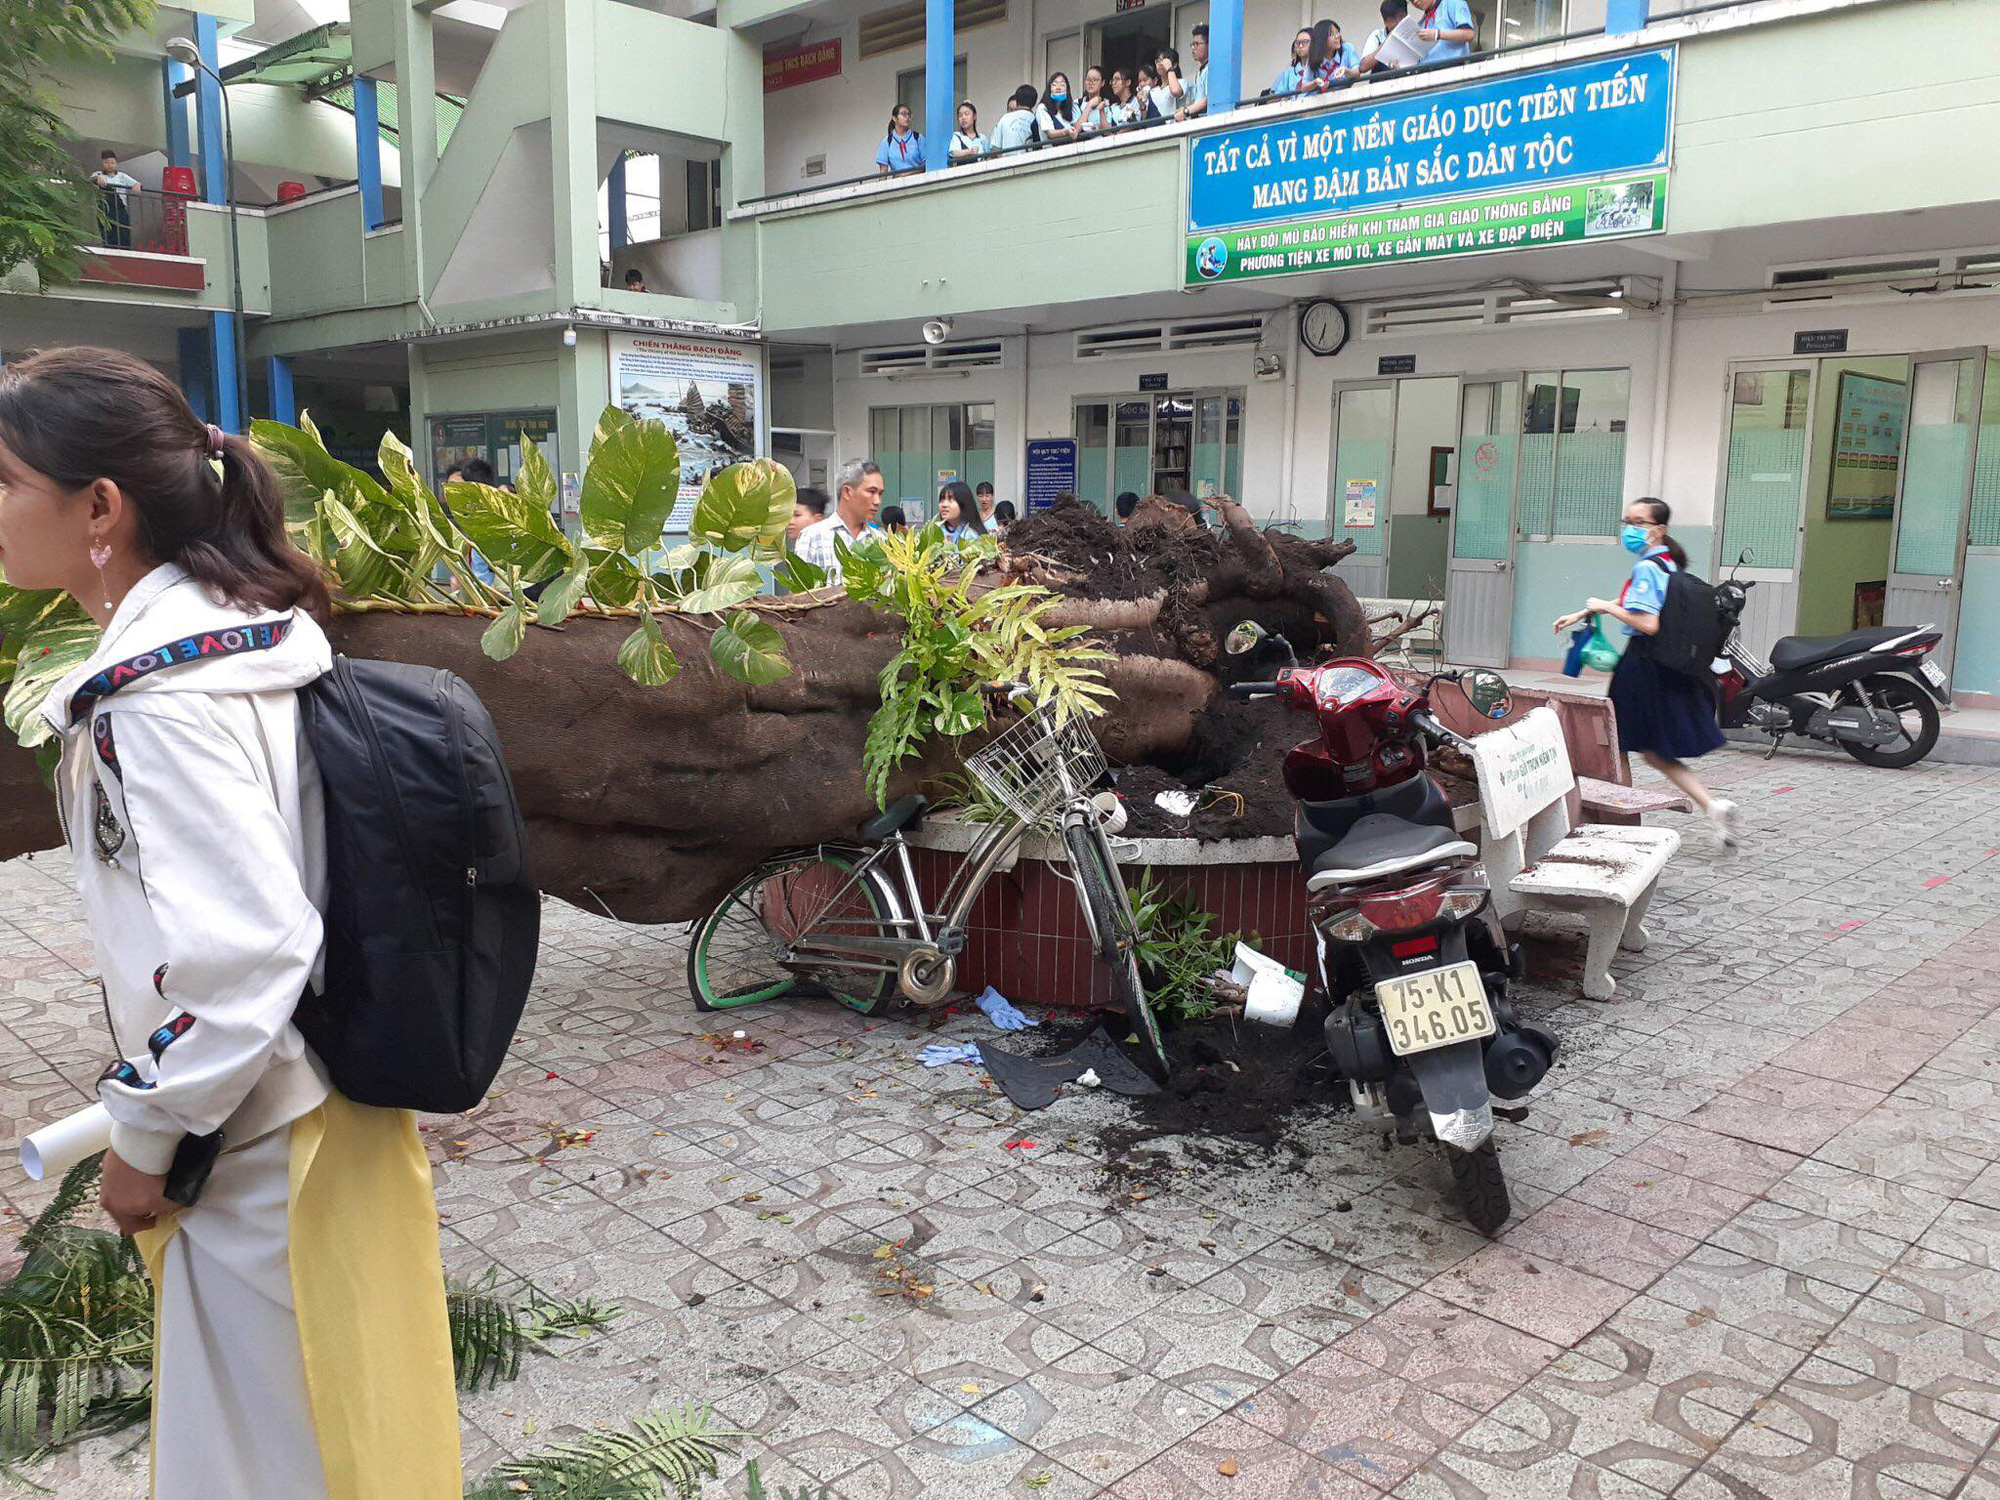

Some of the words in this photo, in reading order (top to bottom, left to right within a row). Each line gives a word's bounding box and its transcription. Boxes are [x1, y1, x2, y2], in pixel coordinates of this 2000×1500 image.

[1204, 138, 1241, 176] TẤT
[1245, 133, 1272, 169] CẢ
[1277, 129, 1298, 163] VÌ
[1303, 124, 1346, 163] MỘT
[1352, 111, 1396, 152] NỀN
[1402, 104, 1456, 144] GIÁO
[1463, 98, 1512, 137] DỤC
[1518, 82, 1577, 123] TIÊN
[1584, 62, 1648, 112] TIẾN
[1252, 177, 1308, 209] MANG
[1313, 166, 1360, 204] ĐẬM
[1365, 155, 1410, 193] BẢN
[1416, 142, 1460, 186] SẮC
[1466, 142, 1516, 179] DÂN
[1523, 132, 1573, 174] TỘC
[1240, 253, 1284, 272] PHƯƠNG
[1287, 248, 1312, 268] TIỆN
[1315, 248, 1330, 263] XE
[1333, 243, 1353, 261] MÔ
[1377, 240, 1392, 256] XE
[1396, 232, 1422, 254] GẮN
[1424, 231, 1454, 251] MÁY
[1457, 228, 1474, 248] VÀ
[1478, 228, 1495, 245] XE
[1498, 224, 1527, 244] ĐẠP
[1530, 218, 1565, 240] ĐIỆN
[1260, 231, 1279, 250] ĐỘI
[1303, 224, 1326, 243] BẢO
[1329, 218, 1359, 241] HIỂM
[1362, 220, 1382, 237] KHI
[1385, 215, 1420, 233] THAM
[1424, 212, 1445, 229] GIA
[1449, 207, 1480, 225] GIAO
[1483, 200, 1529, 221] THÔNG
[1532, 193, 1572, 219] BẰNG
[180, 628, 255, 658] LOVE
[91, 649, 173, 695] LOVE
[1401, 954, 1434, 966] HONDA
[1392, 970, 1466, 1012] 75-K1
[1393, 1000, 1487, 1048] 346.05
